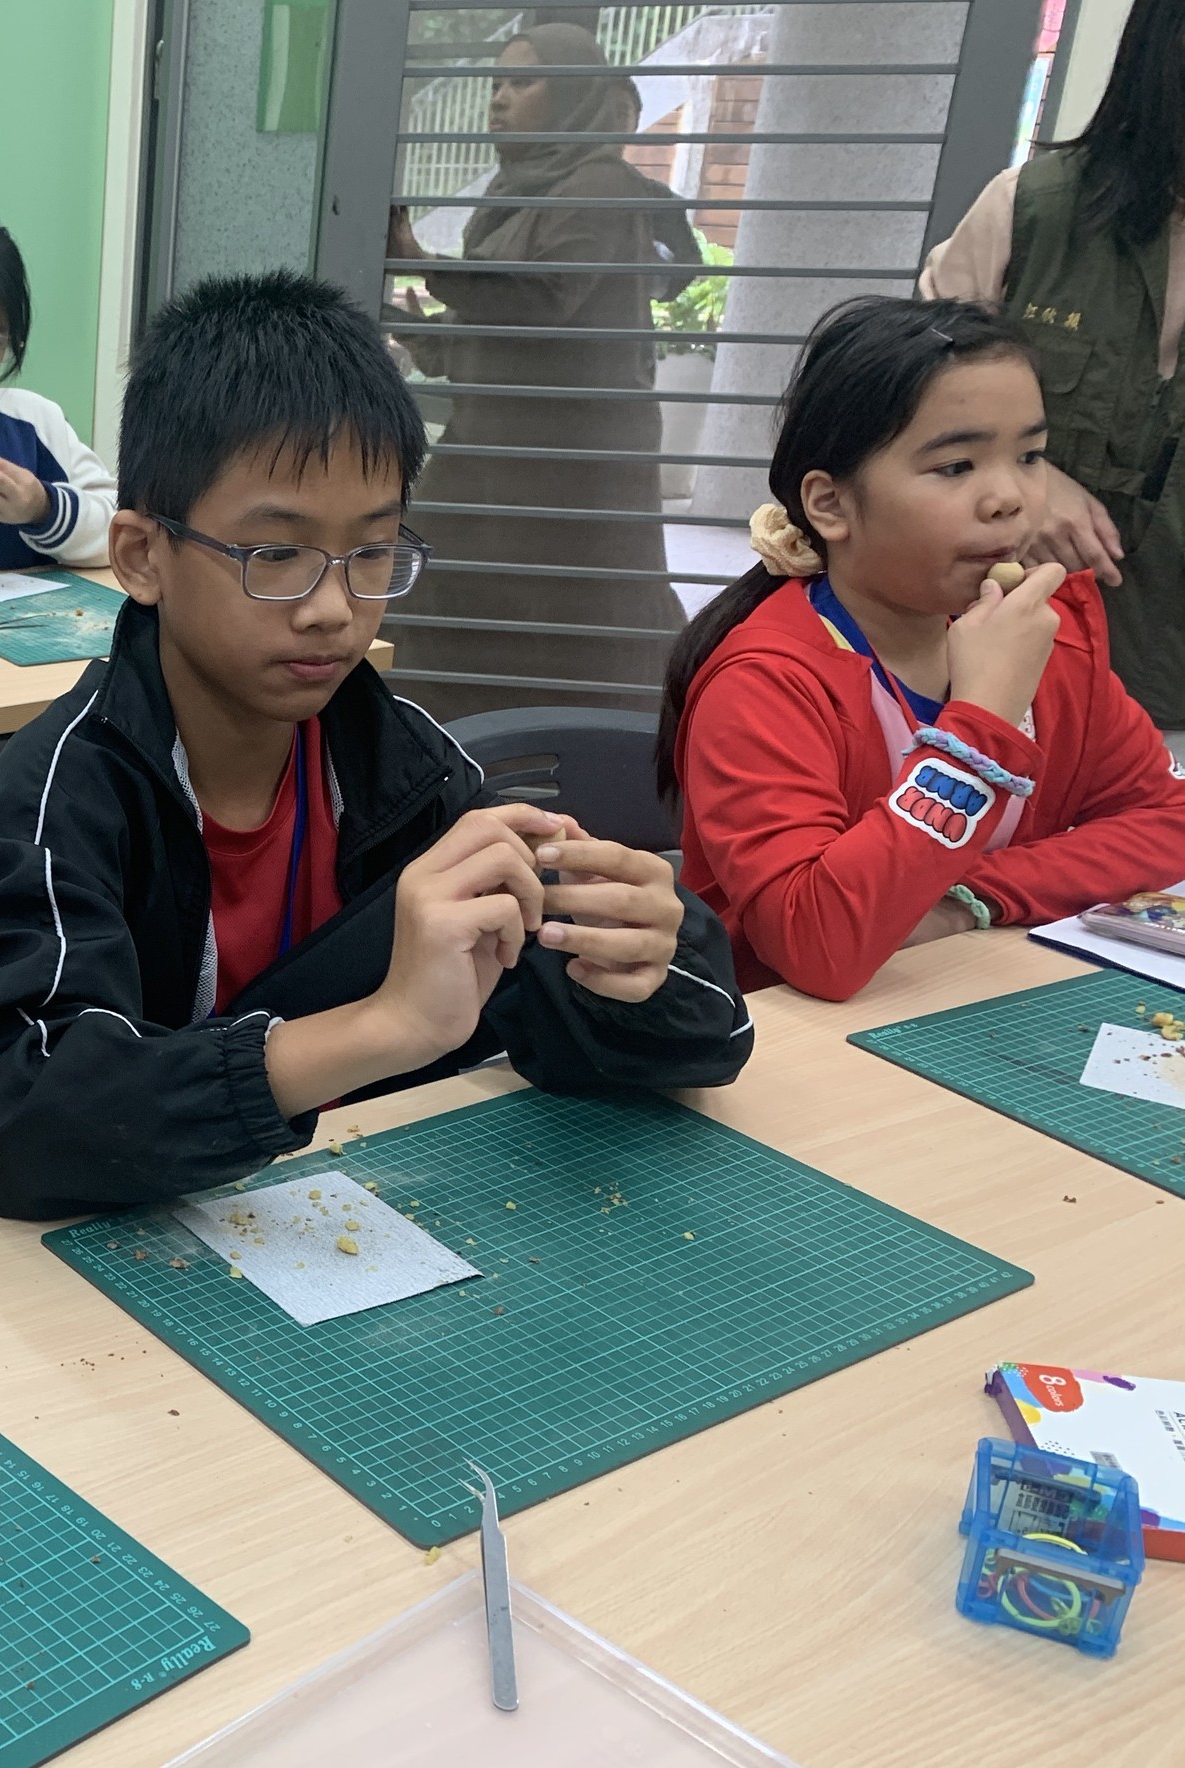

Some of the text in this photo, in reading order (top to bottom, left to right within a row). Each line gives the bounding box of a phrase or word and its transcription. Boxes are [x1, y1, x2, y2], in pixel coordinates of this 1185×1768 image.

[68, 1221, 111, 1238] Really
[137, 1299, 150, 1308] 20
[151, 1309, 162, 1317] 19
[187, 1338, 199, 1346] 16
[199, 1348, 211, 1356] 15
[225, 1368, 237, 1376] 13
[238, 1378, 250, 1387] 12
[251, 1389, 262, 1397] 11
[264, 1399, 277, 1408] 10
[1039, 1374, 1067, 1407] 8 colors
[464, 1506, 474, 1514] 2
[496, 1491, 506, 1500] 4
[527, 1478, 538, 1486] 6
[587, 1451, 601, 1460] 10
[602, 1445, 615, 1453] 11
[617, 1438, 630, 1446] 12
[631, 1432, 645, 1440] 13
[660, 1419, 673, 1427] 15
[674, 1413, 687, 1421] 16
[688, 1407, 700, 1415] 17
[716, 1395, 729, 1403] 19
[728, 1390, 742, 1398] 20
[742, 1384, 755, 1392] 21
[755, 1378, 770, 1386] 22
[769, 1372, 783, 1380] 23
[782, 1366, 795, 1374] 24
[4, 1460, 16, 1469] 14
[17, 1470, 30, 1480] 15
[31, 1481, 44, 1491] 16
[45, 1495, 59, 1503] 17
[61, 1505, 74, 1515] 18
[76, 1517, 89, 1527] 19
[91, 1529, 106, 1540] 20
[107, 1542, 122, 1552] 21
[122, 1554, 138, 1565] 22
[138, 1567, 154, 1578] 23
[154, 1580, 170, 1591] 24
[170, 1593, 187, 1604] 25
[187, 1606, 204, 1618] 26
[203, 1621, 221, 1632] 27
[131, 1635, 217, 1691] Really R-8
